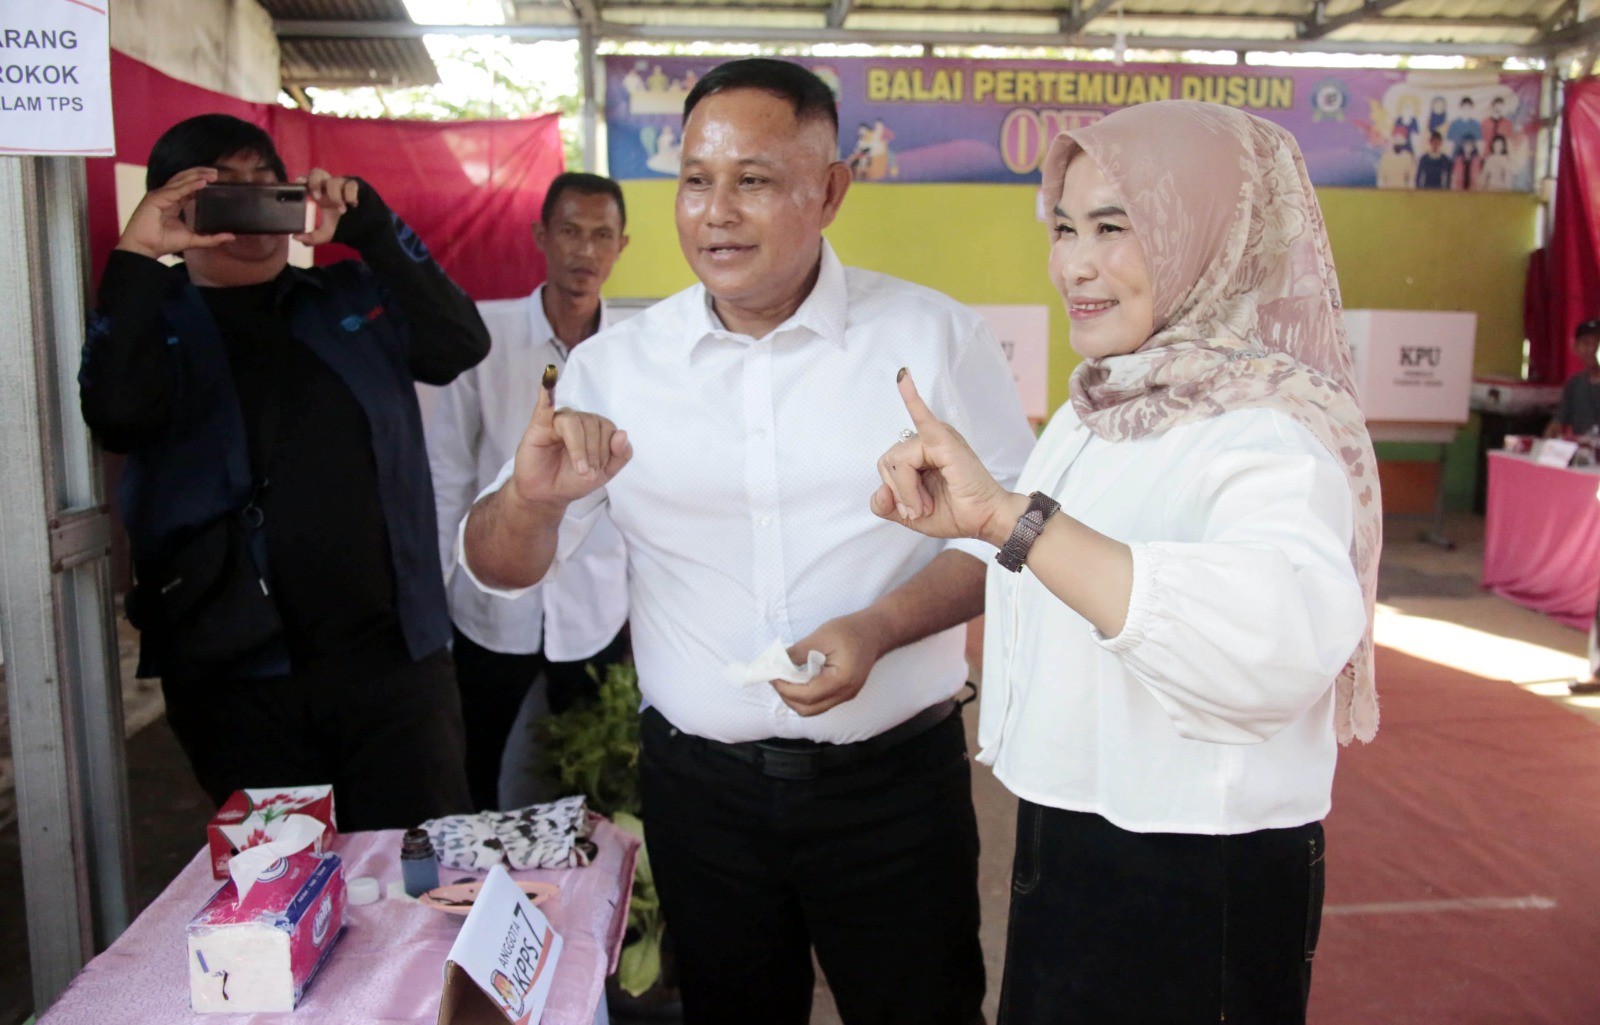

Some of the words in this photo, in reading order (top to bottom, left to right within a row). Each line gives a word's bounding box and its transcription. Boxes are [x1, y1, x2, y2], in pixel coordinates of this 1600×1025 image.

[0, 29, 78, 49] RANG
[0, 65, 79, 84] OKOK
[867, 69, 963, 101] BALAI
[973, 71, 1171, 105] PERTEMUAN
[1181, 75, 1293, 108] DUSUN
[0, 97, 42, 111] LAM
[46, 97, 84, 111] TPS
[1399, 345, 1441, 367] KPU
[513, 901, 544, 948] 7
[498, 921, 521, 970] ANGGOTA
[511, 937, 539, 995] KPPS
